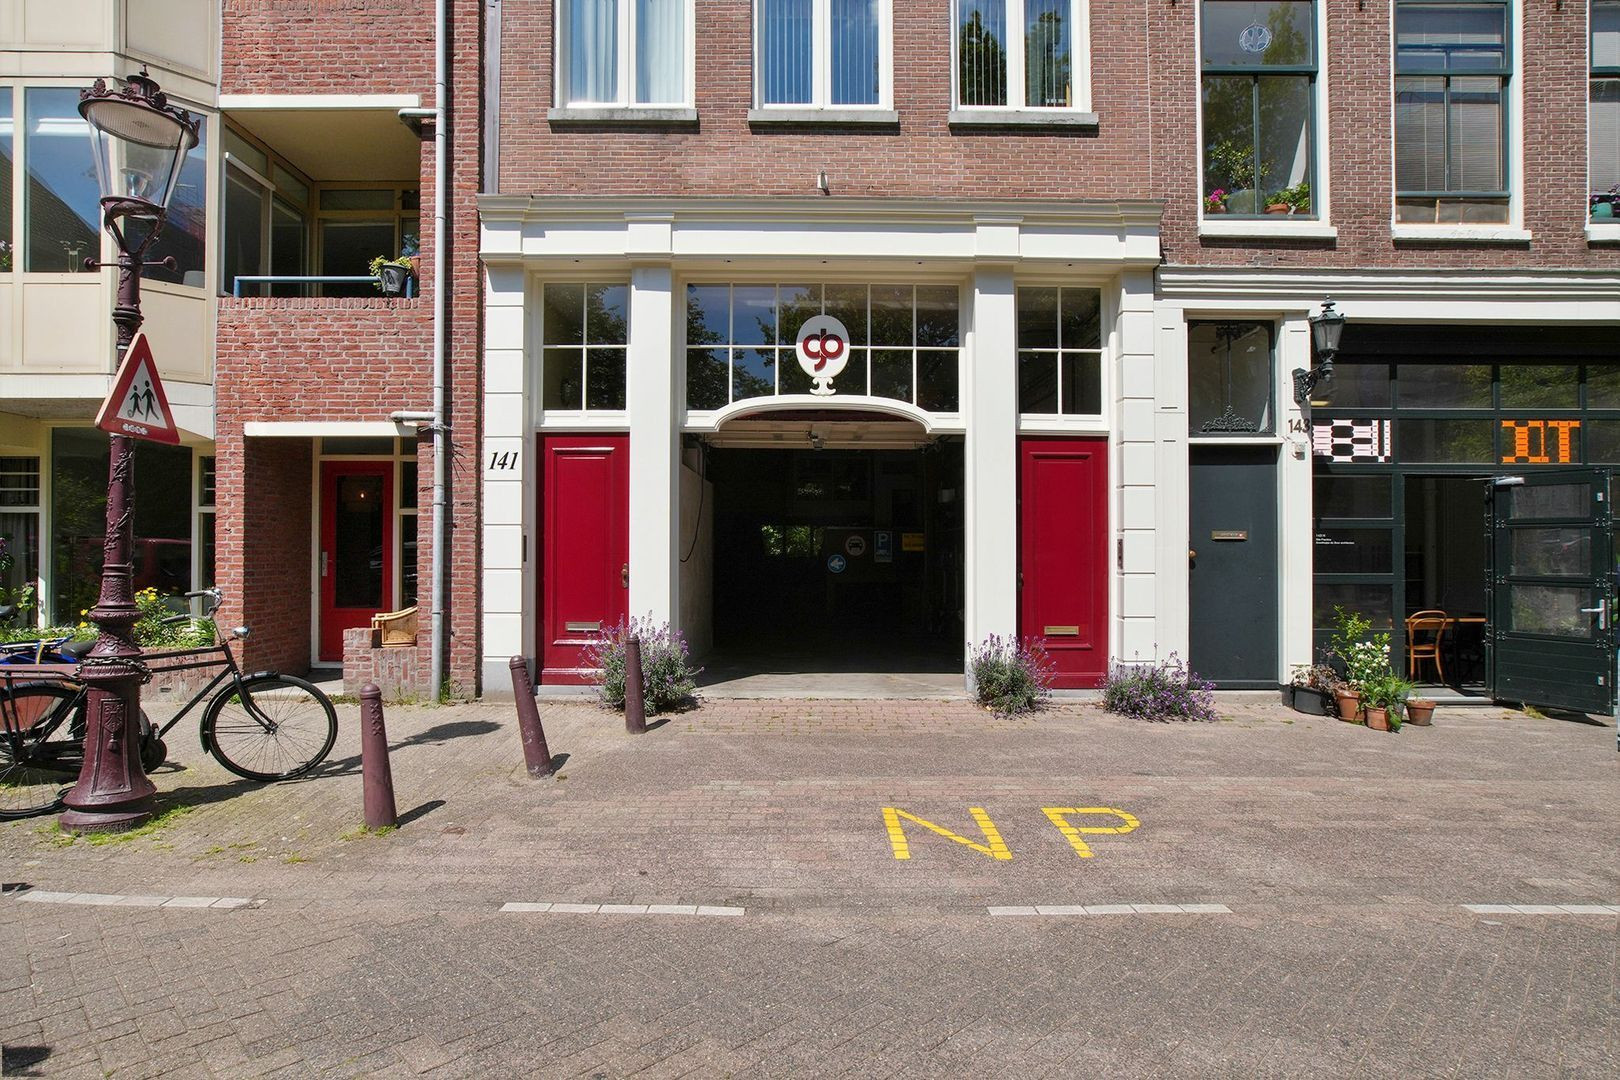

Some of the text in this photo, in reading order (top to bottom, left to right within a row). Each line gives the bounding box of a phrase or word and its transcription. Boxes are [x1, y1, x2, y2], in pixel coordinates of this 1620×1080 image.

[1288, 418, 1310, 433] 143
[489, 451, 519, 470] 141
[878, 533, 888, 547] P
